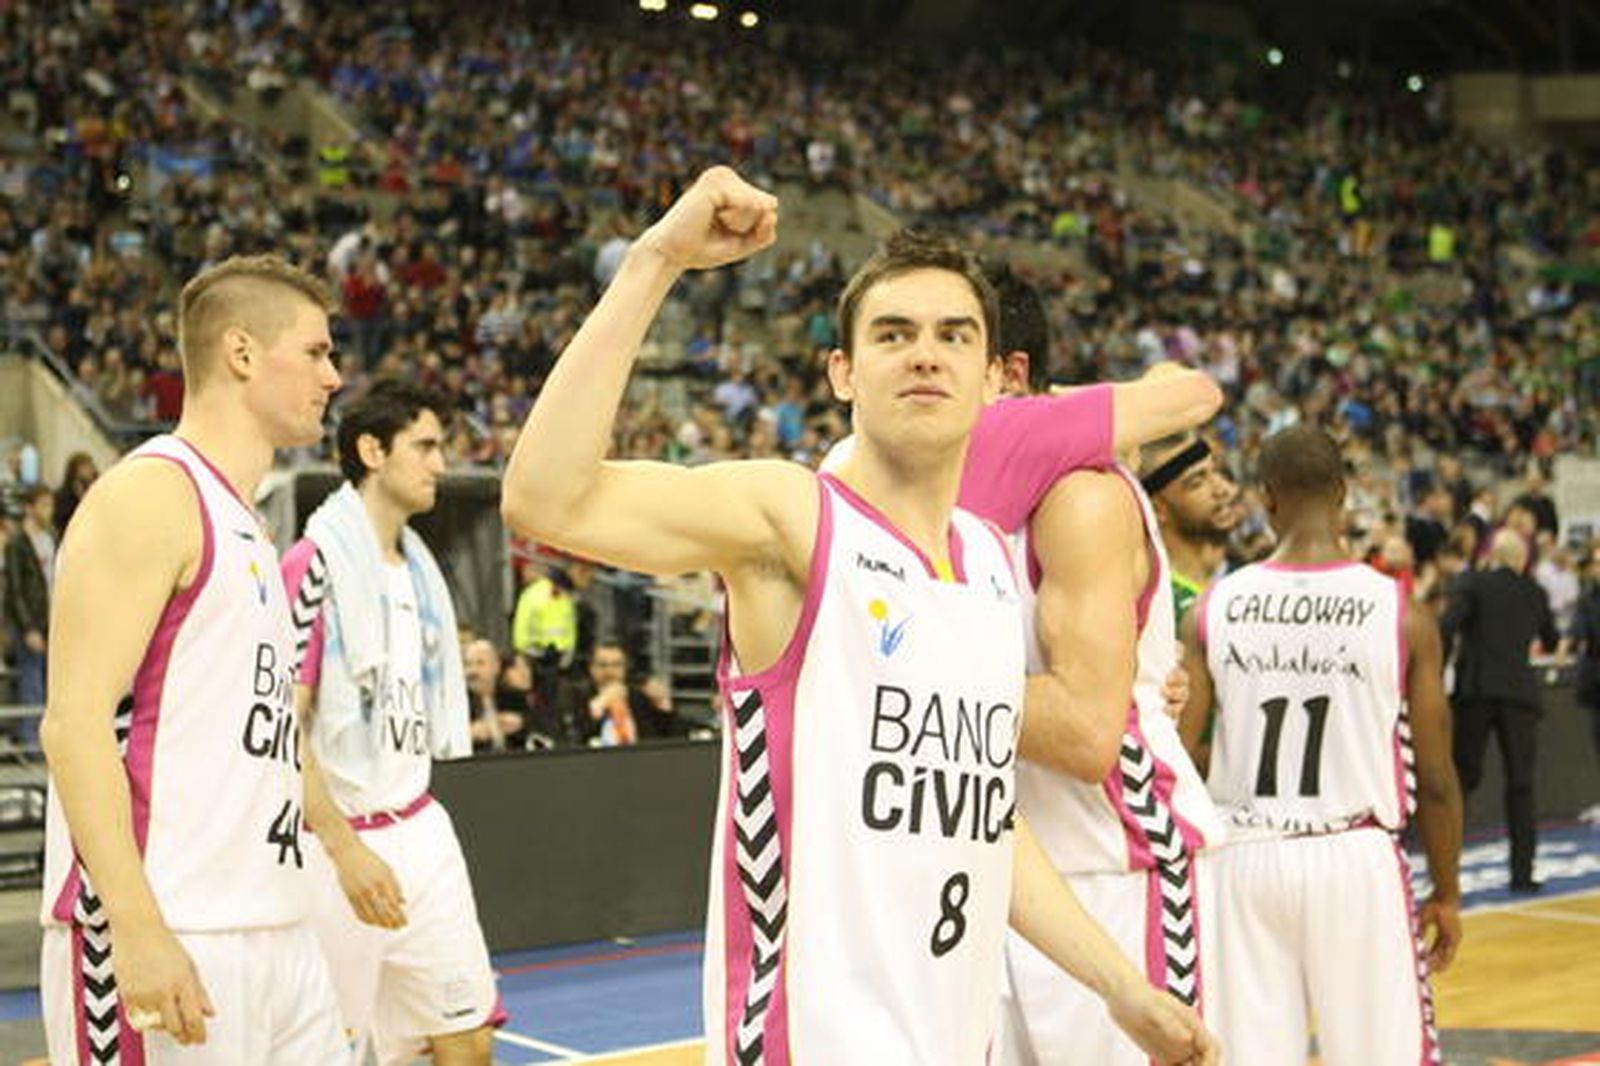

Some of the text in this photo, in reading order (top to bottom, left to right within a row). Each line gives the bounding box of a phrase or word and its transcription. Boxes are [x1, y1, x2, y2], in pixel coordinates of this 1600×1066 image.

[1226, 594, 1375, 626] CALLOWAY
[869, 684, 1019, 770] BANC
[1254, 695, 1331, 797] 11
[929, 870, 970, 958] 8
